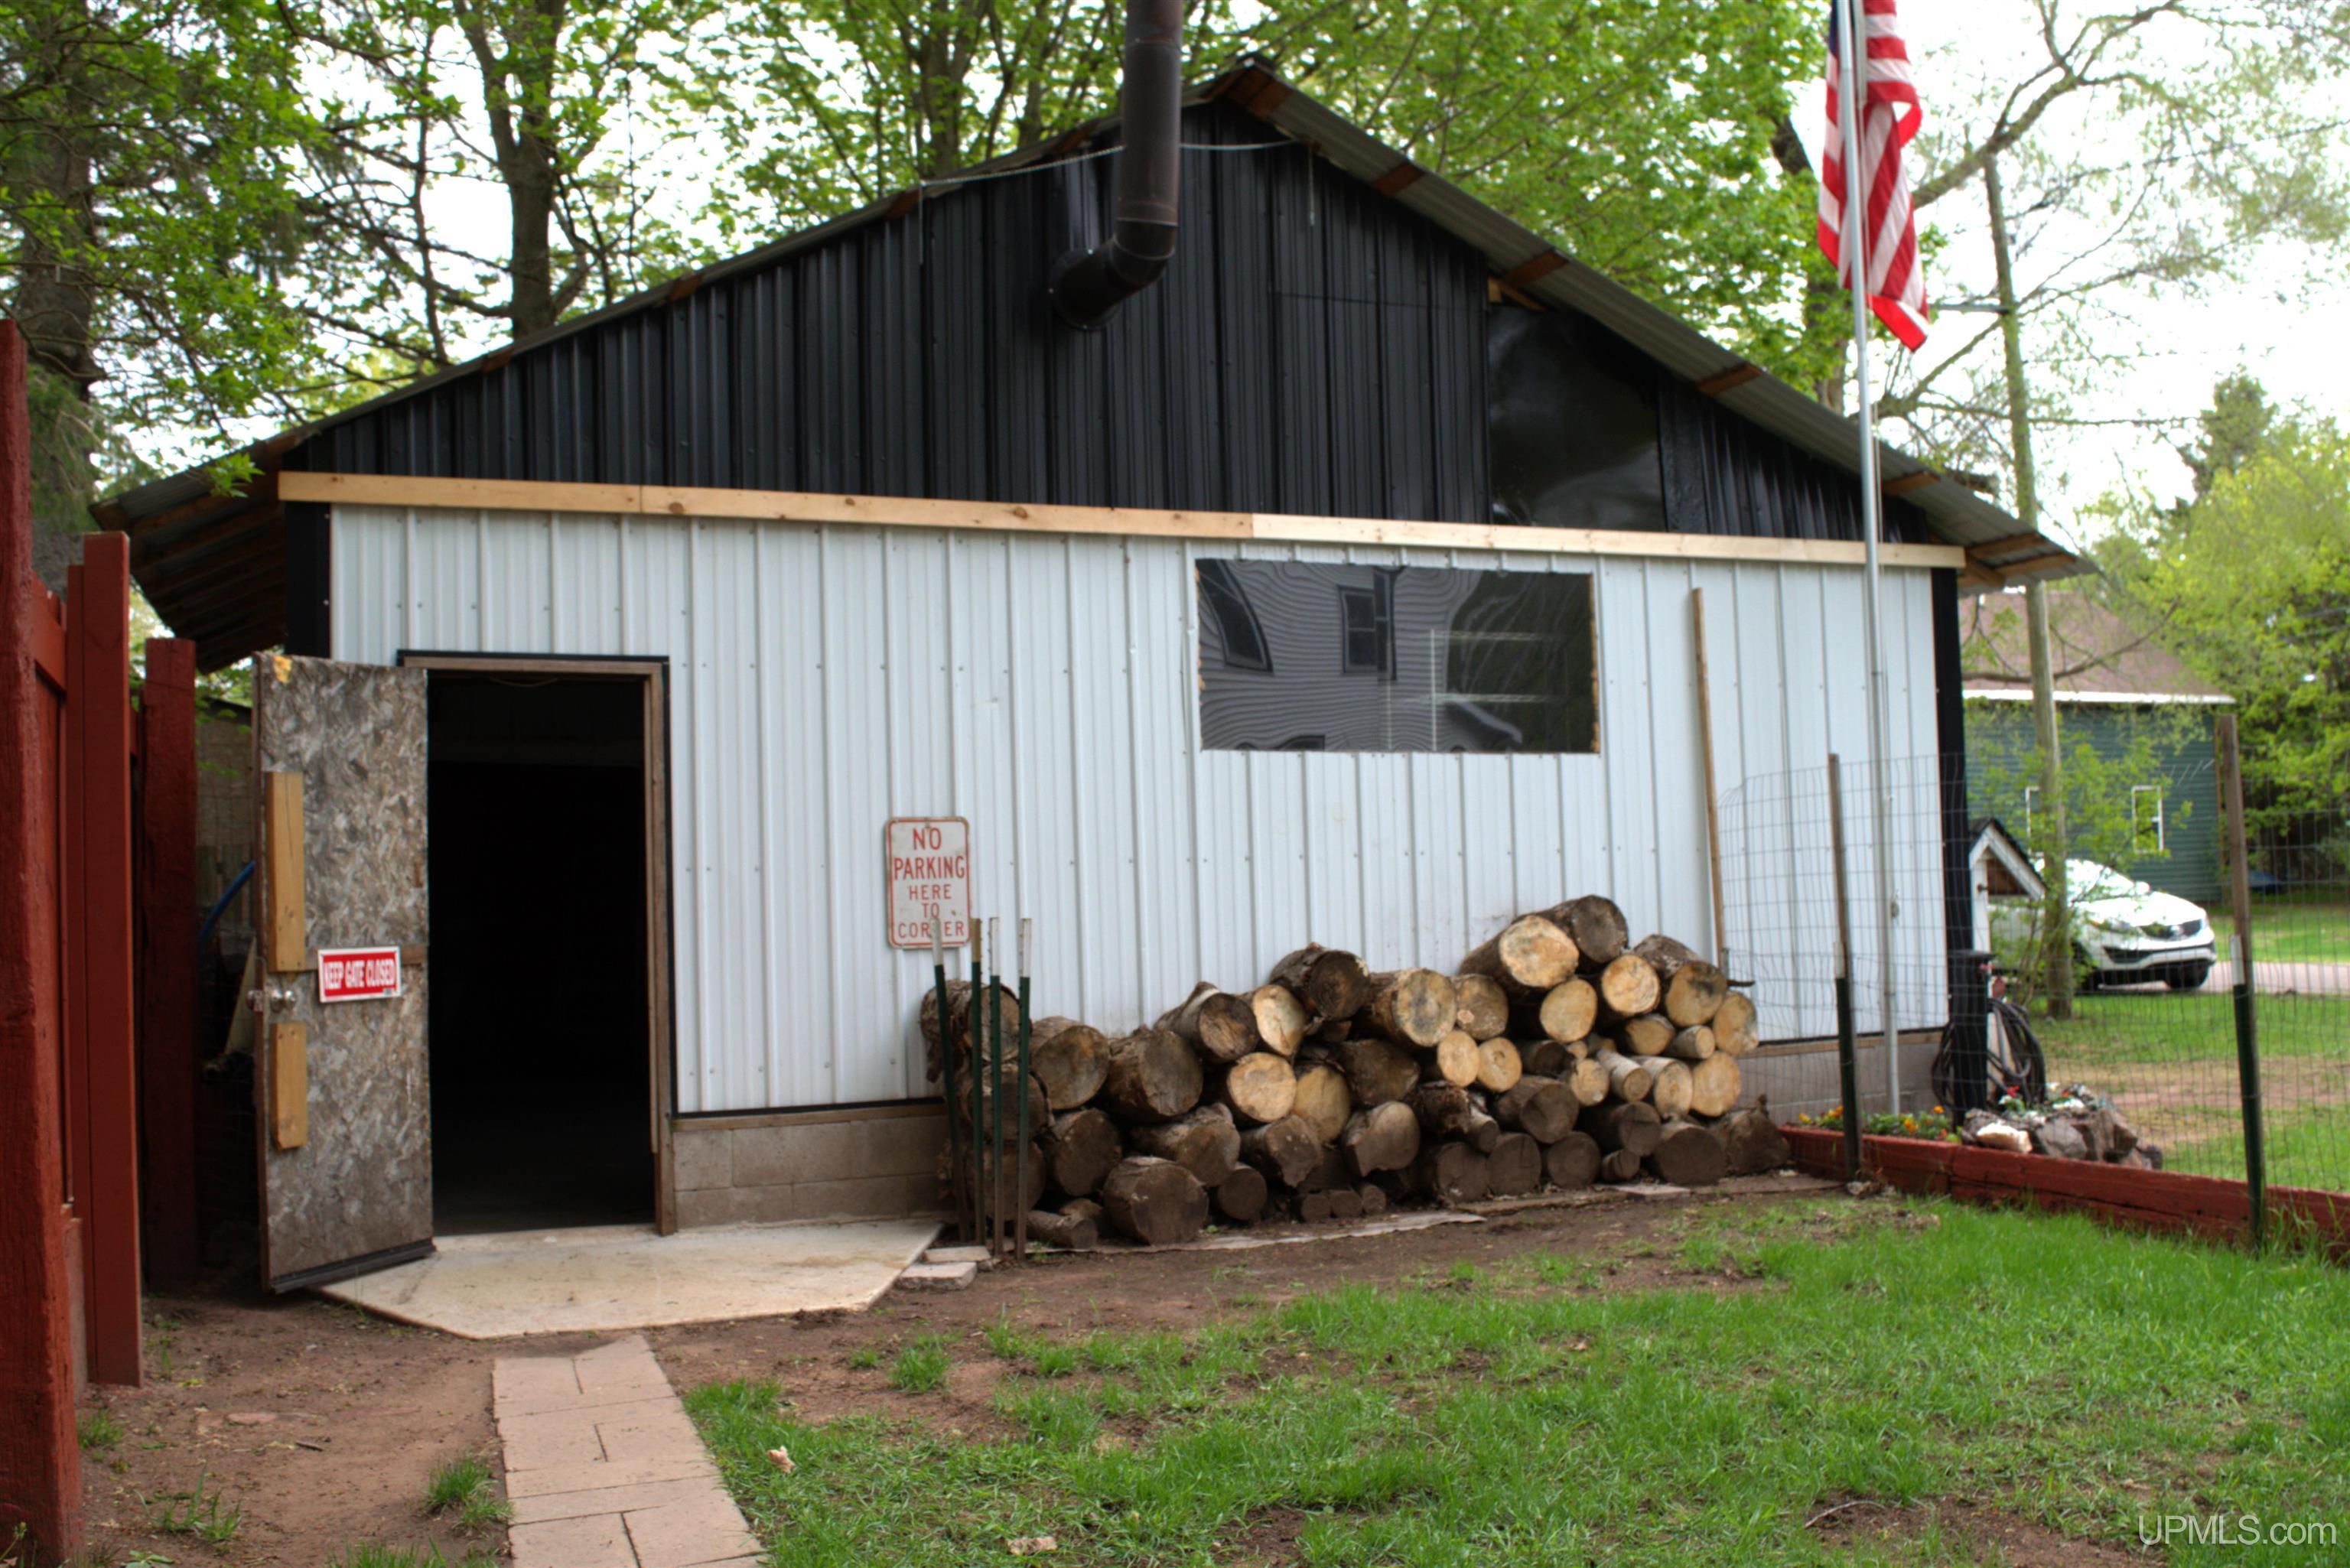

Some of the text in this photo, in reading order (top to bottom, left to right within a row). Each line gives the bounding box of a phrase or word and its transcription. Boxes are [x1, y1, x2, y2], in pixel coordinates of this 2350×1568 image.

[913, 828, 942, 851] NO
[893, 856, 965, 880] PARKING
[909, 883, 952, 900] HERE
[922, 903, 940, 919] TO
[898, 921, 964, 939] CORER
[324, 958, 395, 991] KEEP GATE CLOSED
